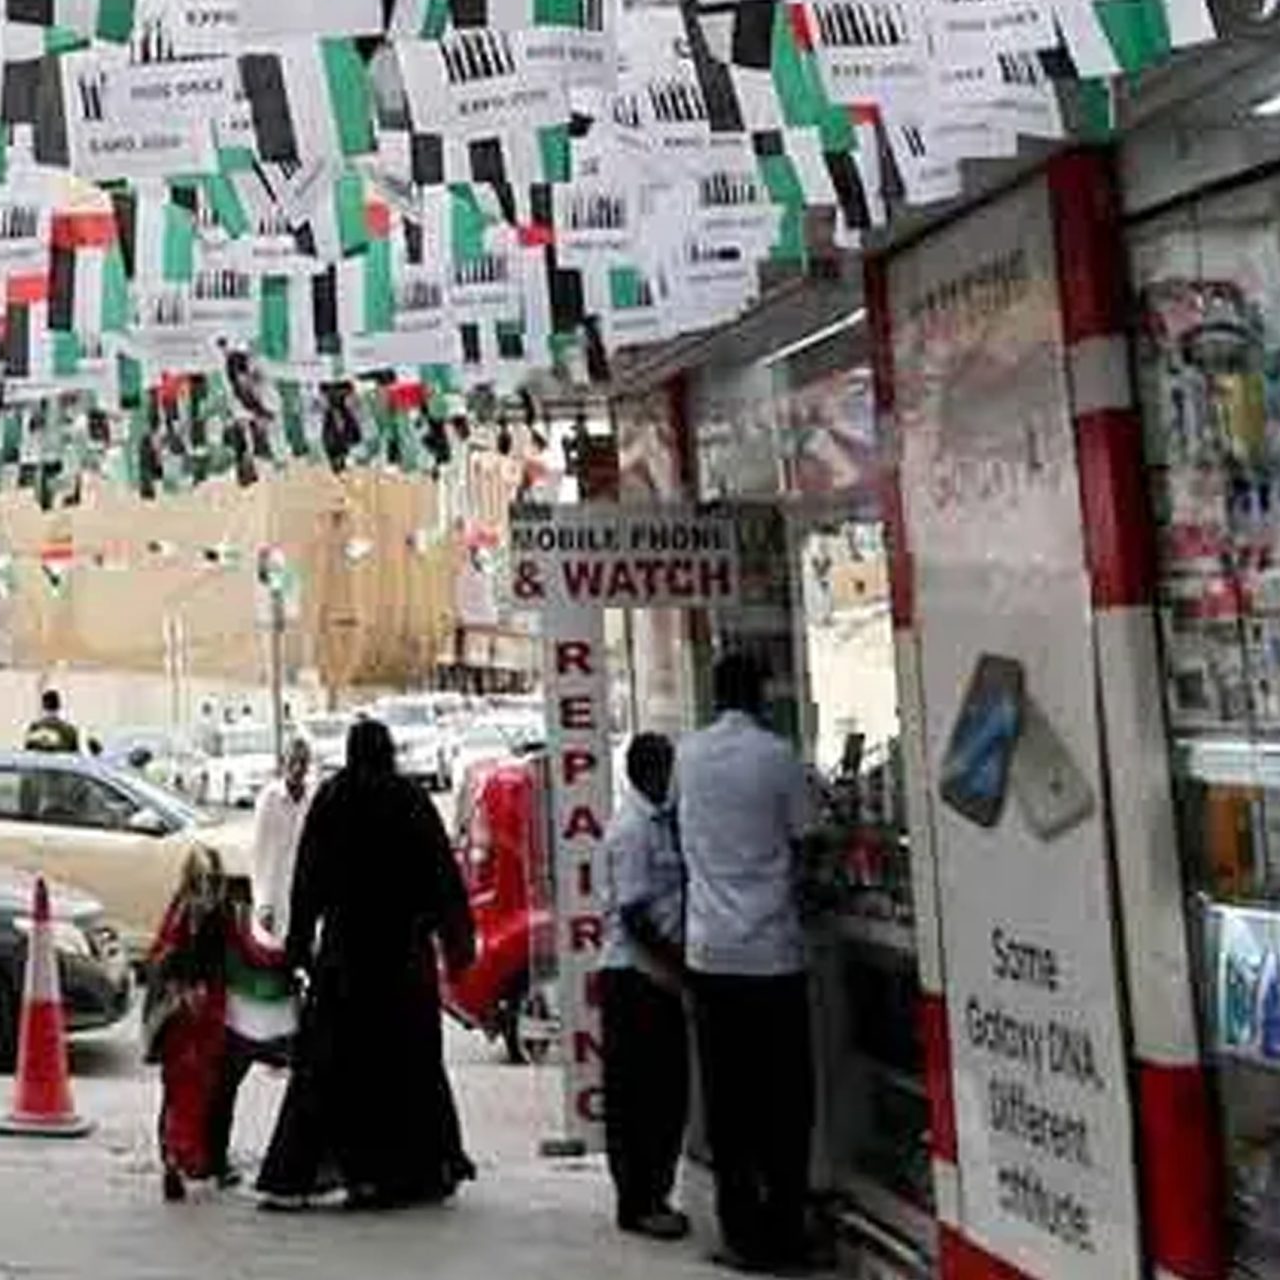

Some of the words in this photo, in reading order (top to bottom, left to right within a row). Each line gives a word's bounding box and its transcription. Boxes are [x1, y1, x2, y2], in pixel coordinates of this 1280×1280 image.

[511, 524, 618, 553] MOBILE
[631, 523, 726, 553] PHONE
[512, 560, 545, 599] &
[563, 558, 733, 599] WATCH
[965, 995, 1043, 1084] Galaxy
